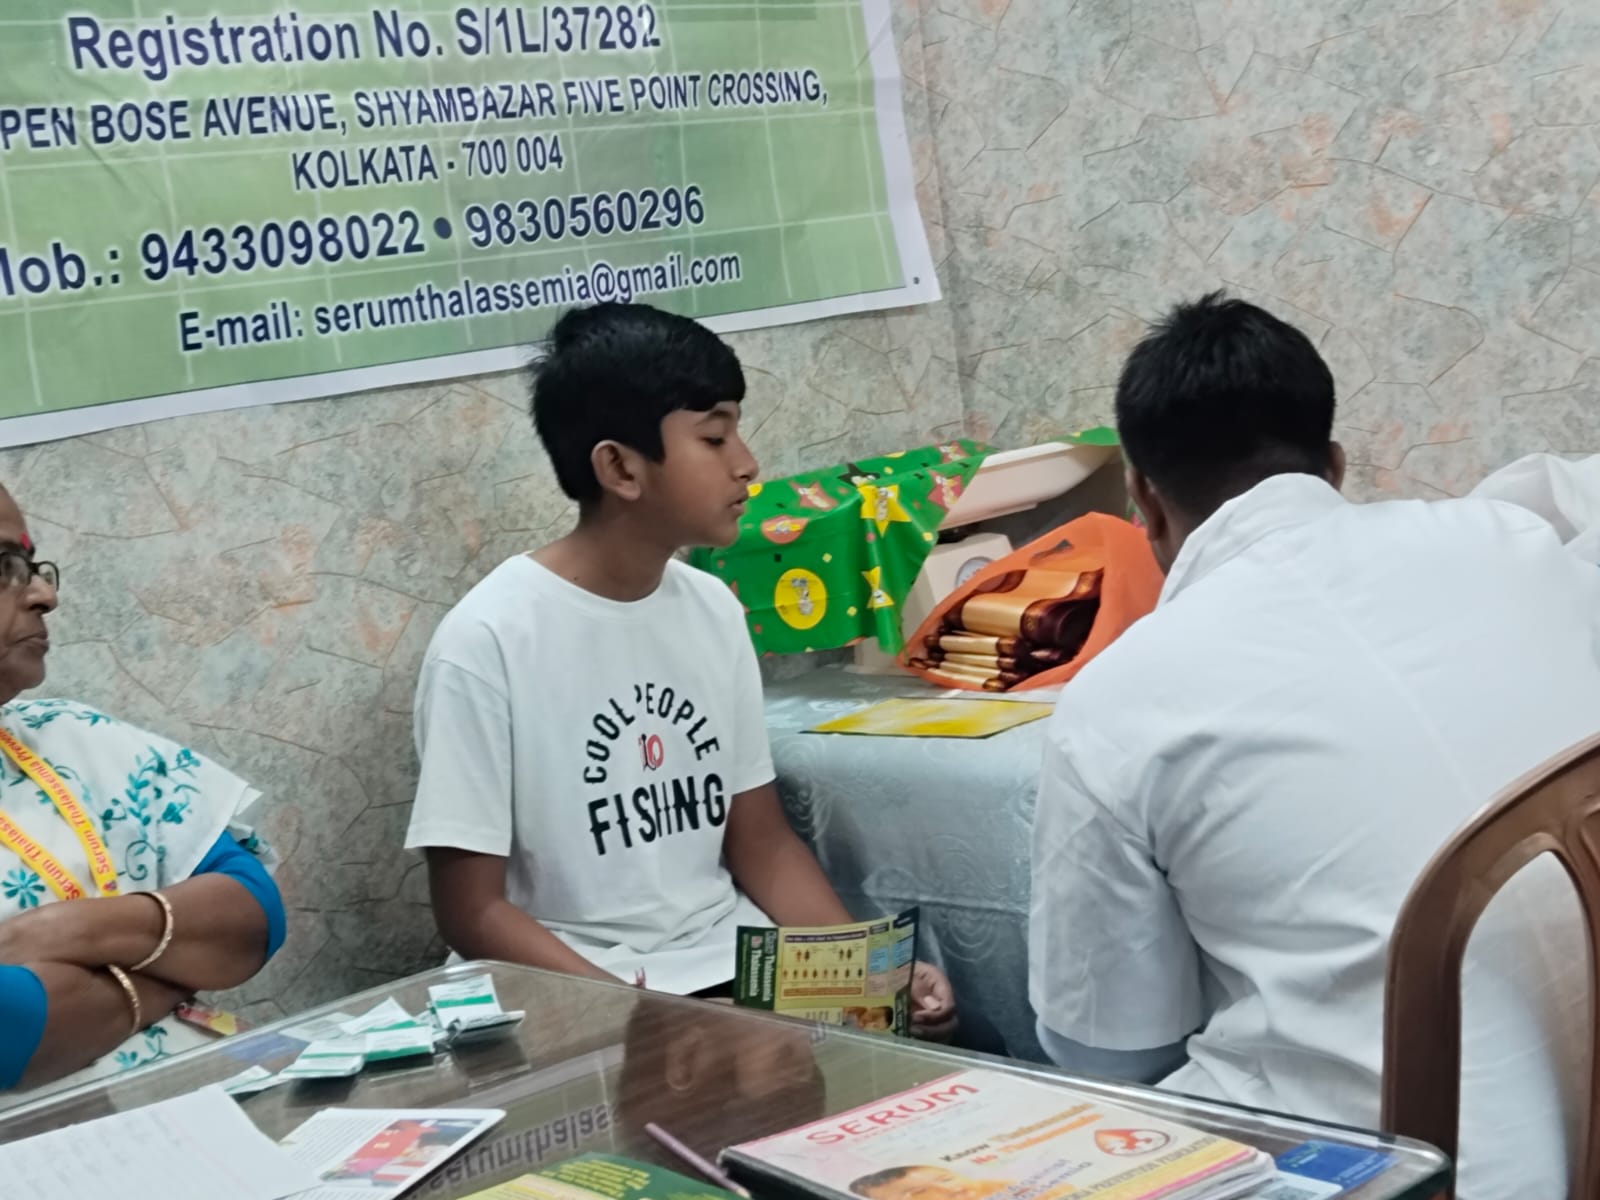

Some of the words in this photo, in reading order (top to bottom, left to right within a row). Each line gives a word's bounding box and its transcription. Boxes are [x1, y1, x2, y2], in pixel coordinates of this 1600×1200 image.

[69, 13, 361, 81] Registration
[373, 10, 443, 58] No.
[456, 5, 661, 55] S/1L/37282
[0, 107, 77, 150] PEN
[91, 100, 191, 144] BOSE
[204, 93, 347, 137] AVENUE,
[356, 82, 557, 130] SHYAMBAZAR
[565, 79, 625, 115] FIVE
[630, 75, 701, 111] POINT
[708, 70, 828, 106] CROSSING,
[292, 144, 438, 190] KOLKATA
[462, 139, 507, 176] 700
[517, 135, 563, 172] 004
[141, 210, 425, 281] 9433098022
[465, 185, 704, 248] 9830560296
[180, 301, 303, 352] E-mail:
[315, 254, 741, 335] serumthalassemia@gmail.com
[583, 698, 636, 785] COOL
[29, 760, 86, 828] Thalassemia
[42, 858, 81, 900] Serum
[83, 829, 111, 875] Serum
[806, 1083, 979, 1145] SERUM
